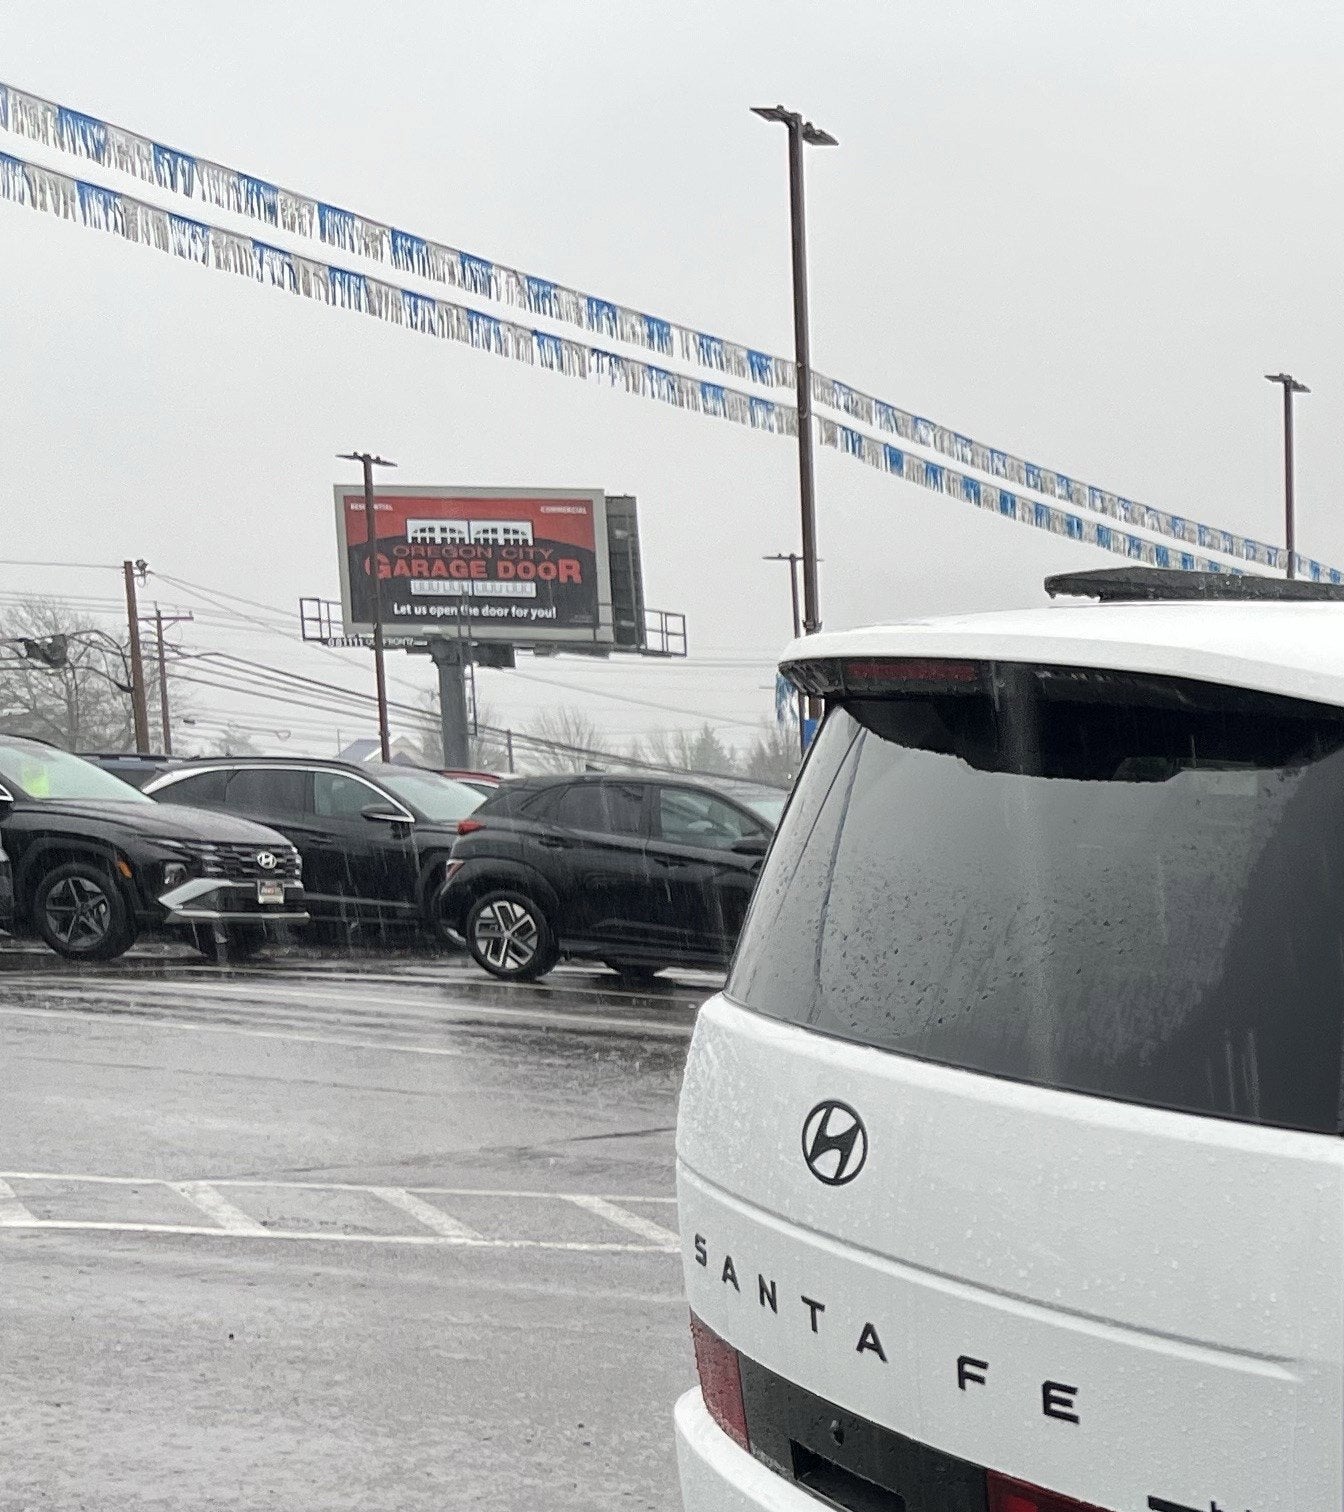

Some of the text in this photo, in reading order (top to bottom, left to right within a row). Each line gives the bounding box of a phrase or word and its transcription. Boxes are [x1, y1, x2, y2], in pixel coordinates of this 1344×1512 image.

[392, 544, 554, 560] OREGON CITY
[364, 551, 582, 584] GARAGE DOOR
[393, 602, 412, 615] Let
[414, 604, 428, 616] us
[428, 605, 458, 618] open
[460, 604, 480, 616] the
[481, 604, 510, 617] door
[511, 604, 529, 618] for
[530, 606, 556, 621] you!
[694, 1232, 1080, 1424] SANTA FE
